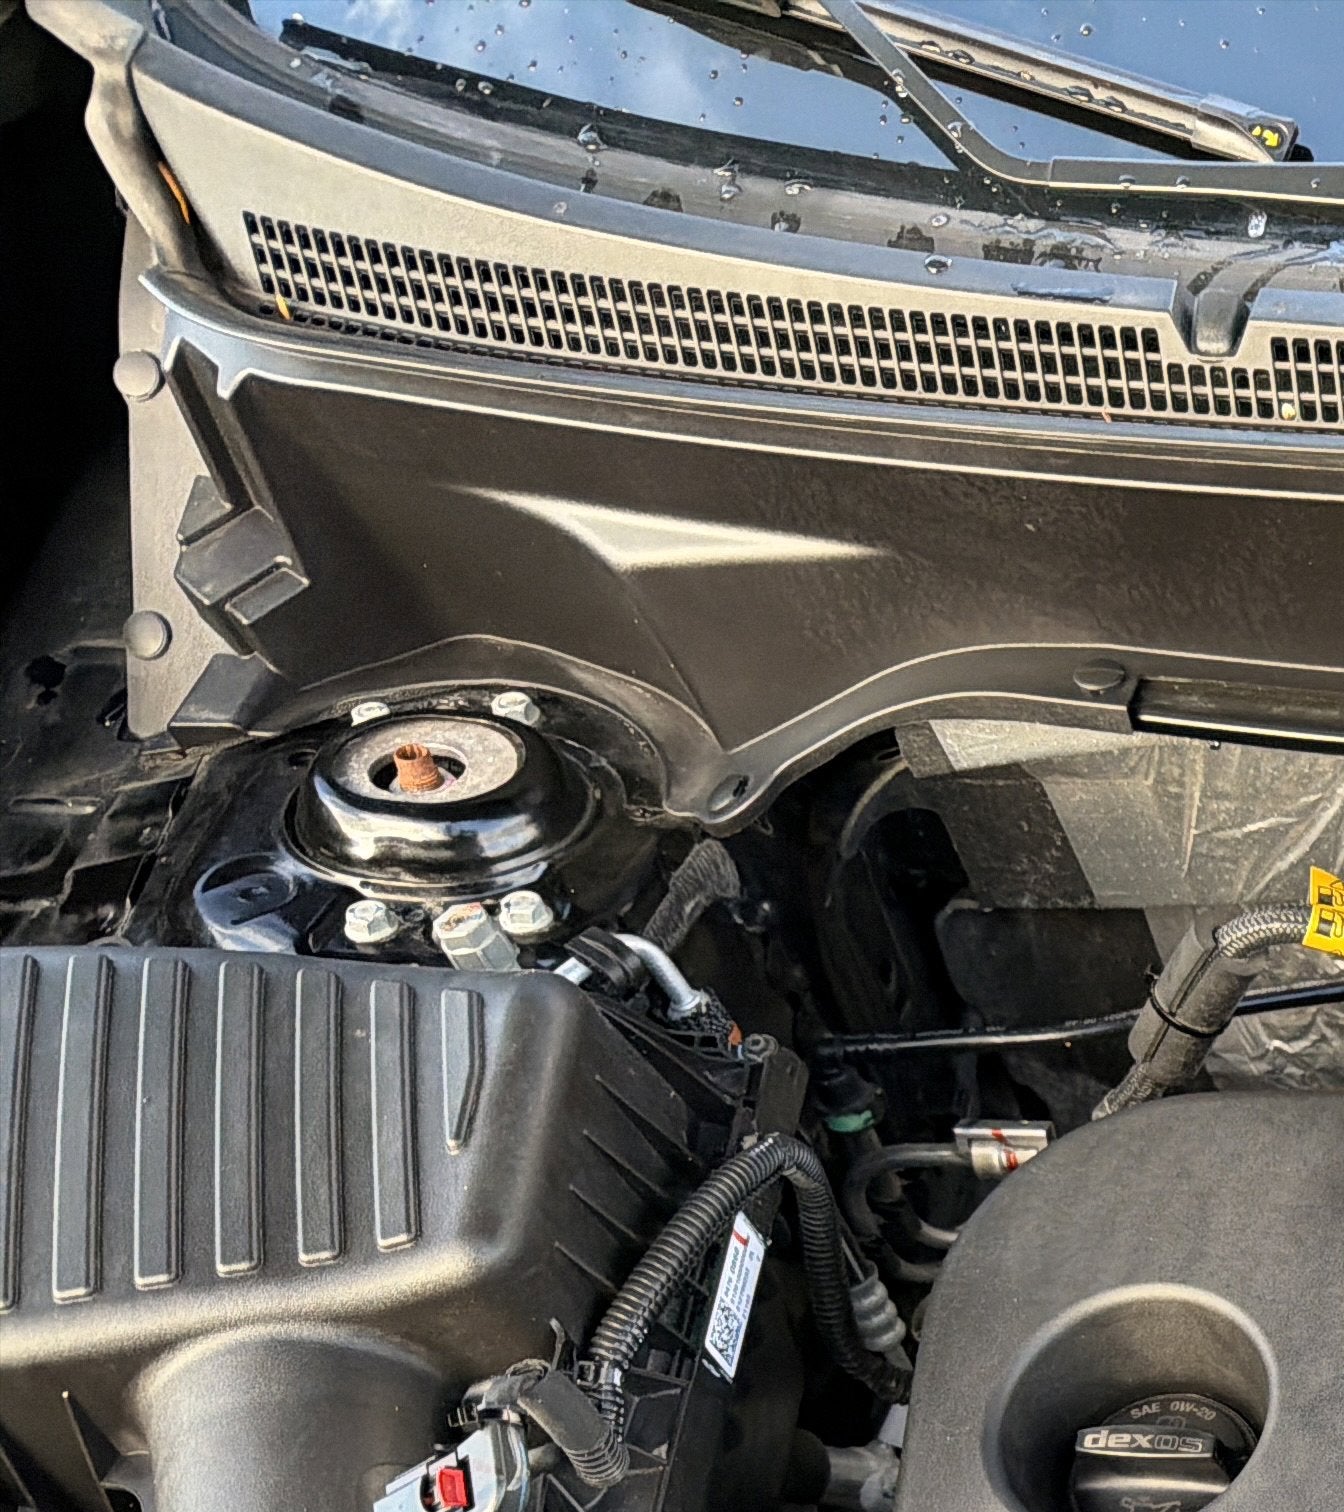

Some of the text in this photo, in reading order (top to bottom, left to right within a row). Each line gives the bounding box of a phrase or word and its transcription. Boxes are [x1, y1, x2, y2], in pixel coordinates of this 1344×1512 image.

[1130, 1400, 1217, 1421] SAE 0W-20
[1083, 1429, 1203, 1453] dexos
